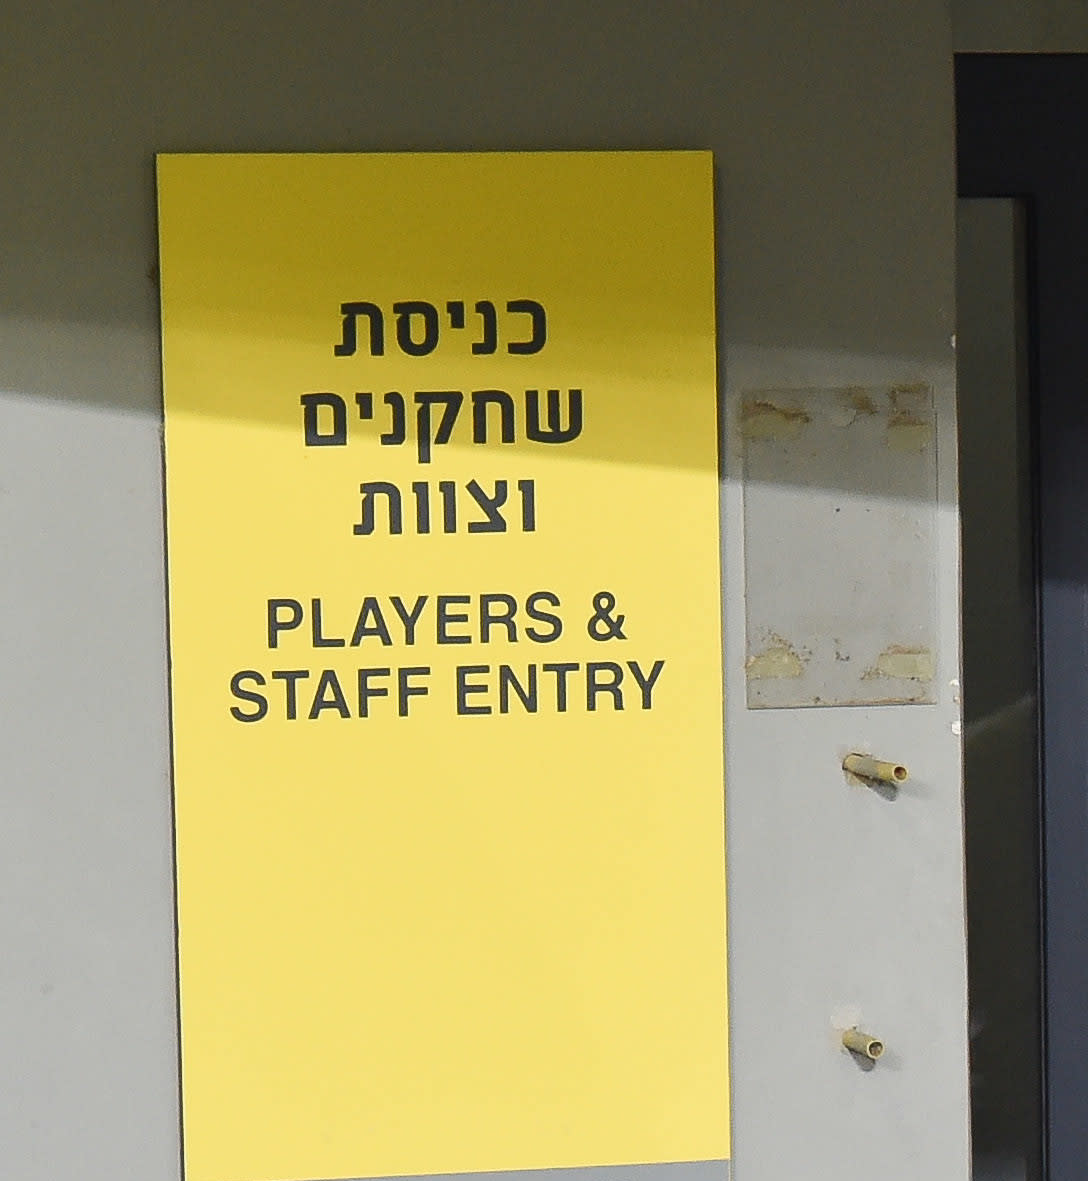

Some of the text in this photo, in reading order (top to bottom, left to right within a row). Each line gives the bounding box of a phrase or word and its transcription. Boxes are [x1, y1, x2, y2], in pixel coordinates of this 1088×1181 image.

[334, 298, 548, 357] כניסת
[300, 388, 584, 464] שחקנים
[352, 478, 537, 536] וצוות
[266, 591, 629, 649] PLAYERS &
[229, 660, 665, 723] STAFF ENTRY
